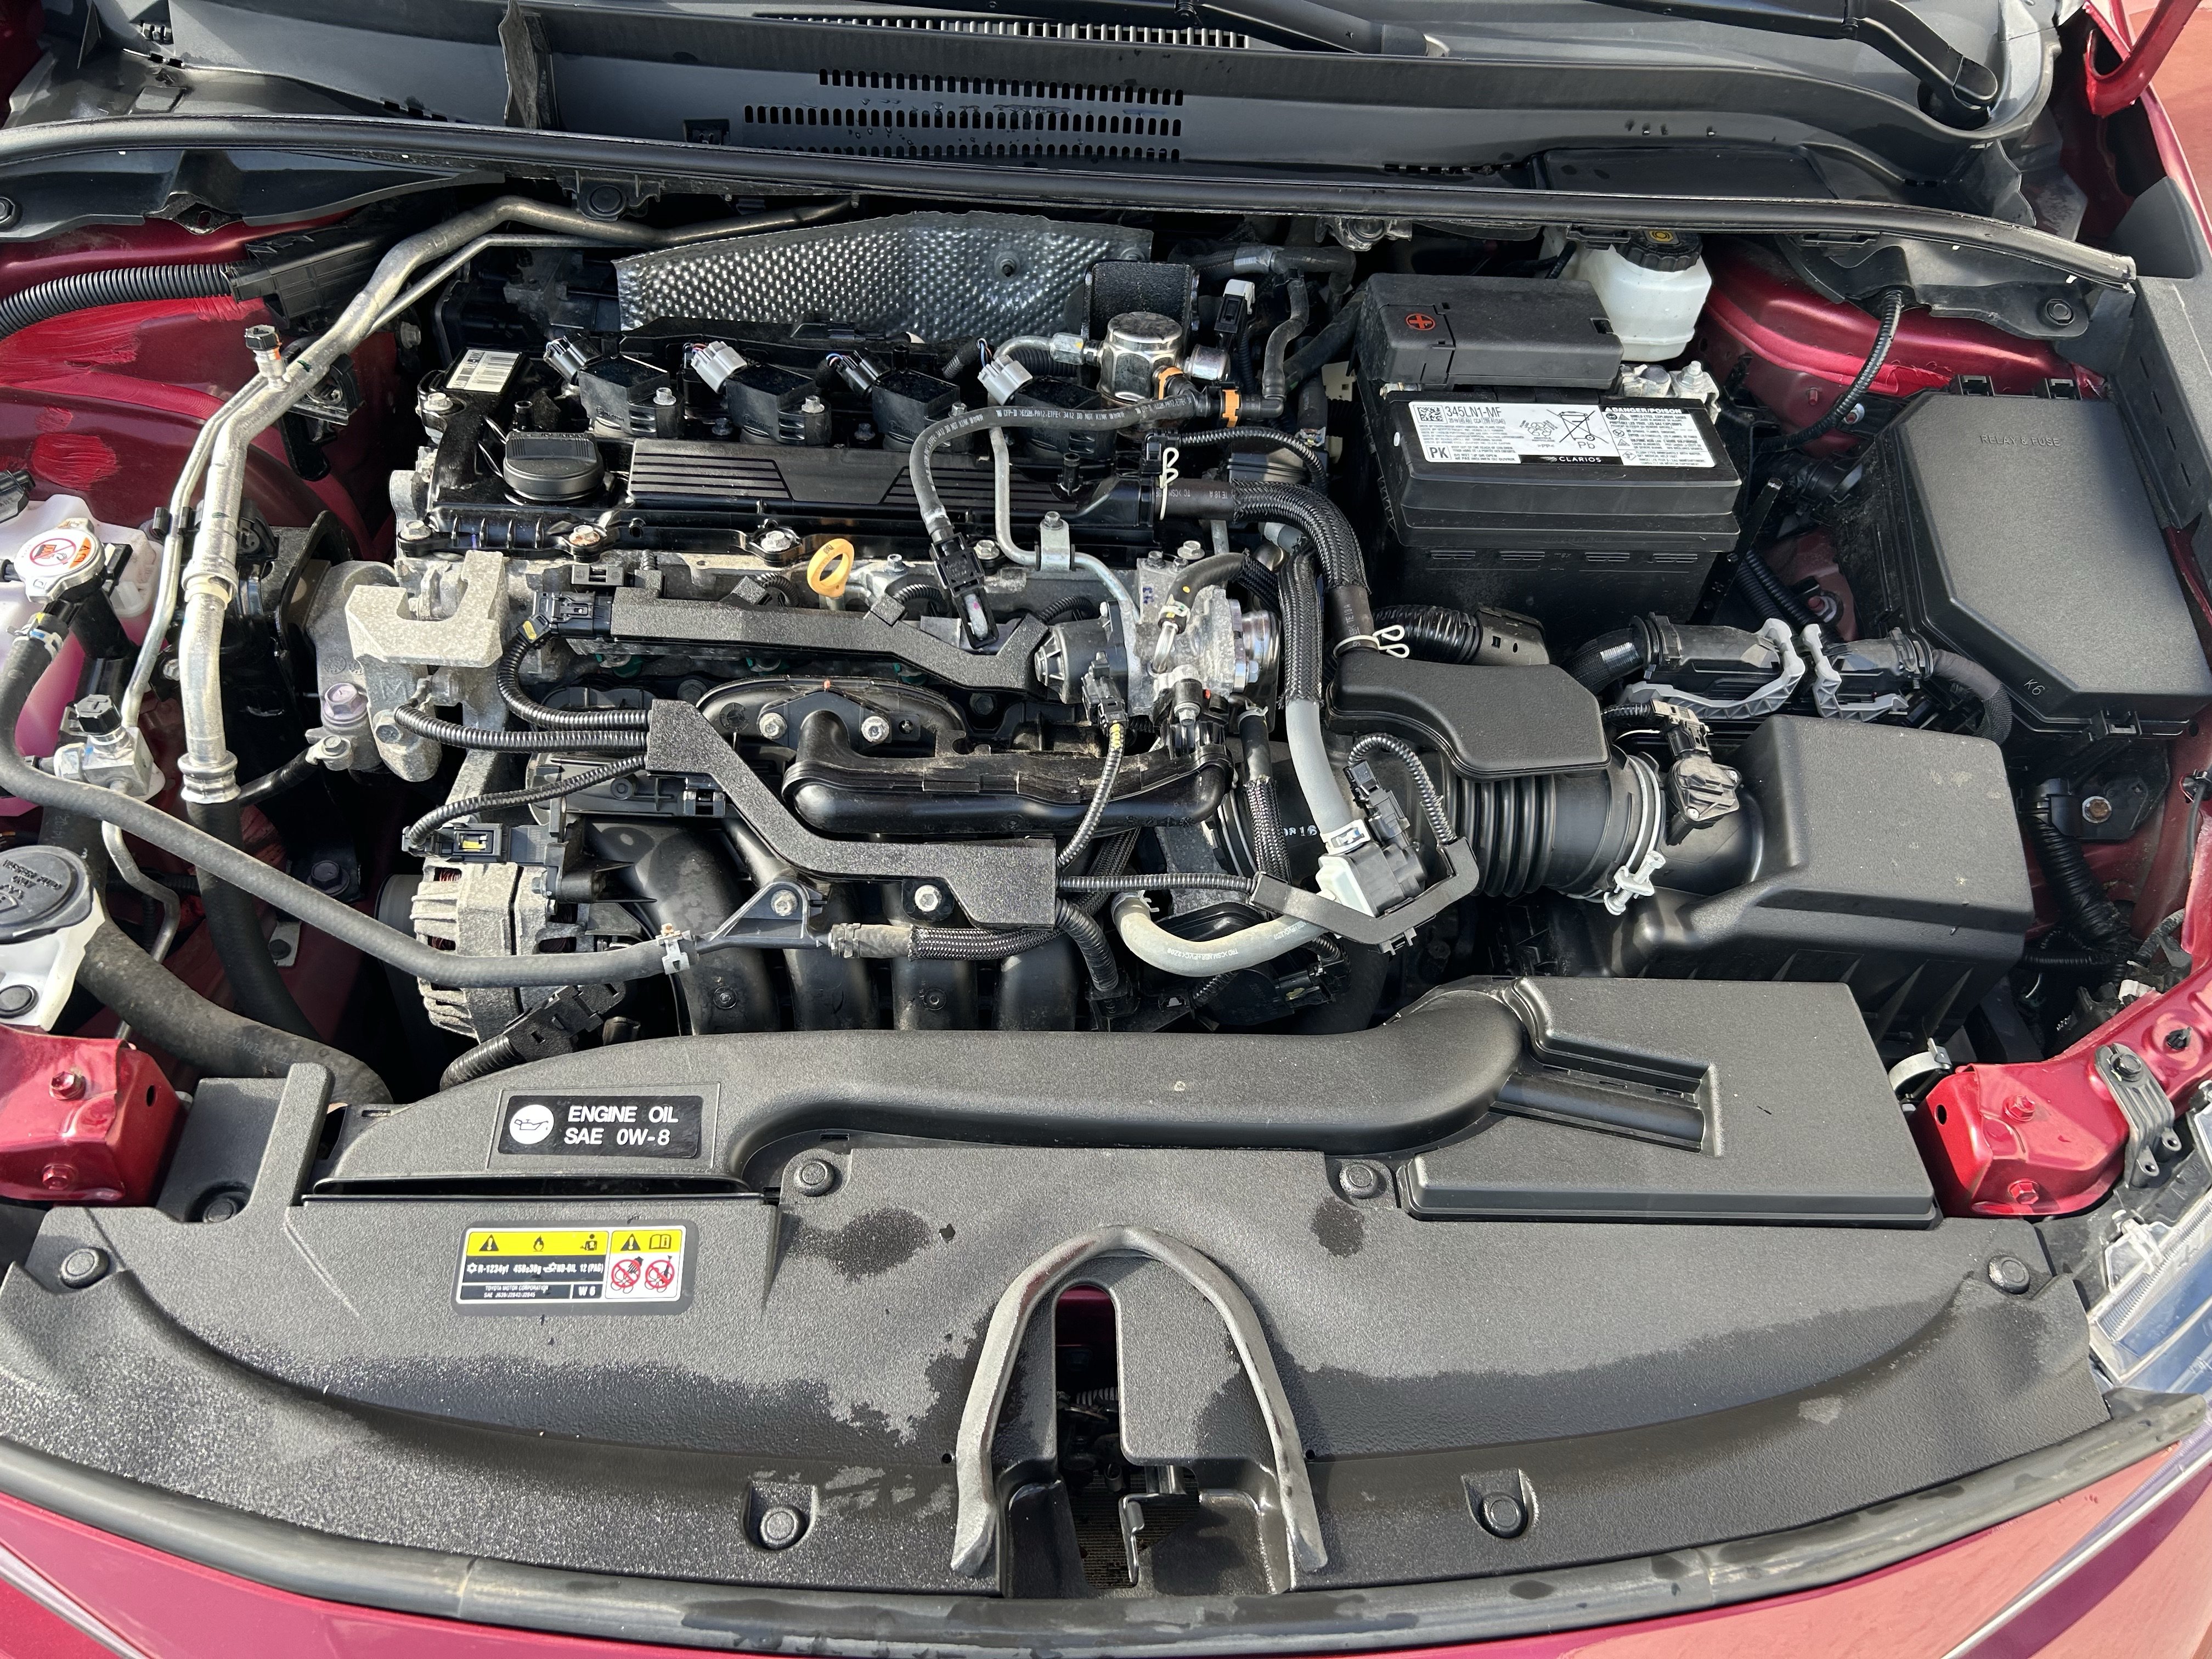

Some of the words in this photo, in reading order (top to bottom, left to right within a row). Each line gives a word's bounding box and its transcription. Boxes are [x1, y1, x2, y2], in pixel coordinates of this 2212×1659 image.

[1445, 406, 1502, 417] 345LN1-MF
[1980, 435, 2017, 445] RELAY
[2020, 436, 2028, 445] &
[2031, 437, 2063, 447] FUSE
[1430, 447, 1448, 459] PK
[2023, 678, 2045, 696] K6
[567, 1106, 638, 1123] ENGINE
[648, 1106, 679, 1123] OIL
[563, 1128, 604, 1144] SAE
[616, 1128, 671, 1146] 0W-8
[580, 1264, 587, 1273] 12
[588, 1263, 603, 1273] (PAG)
